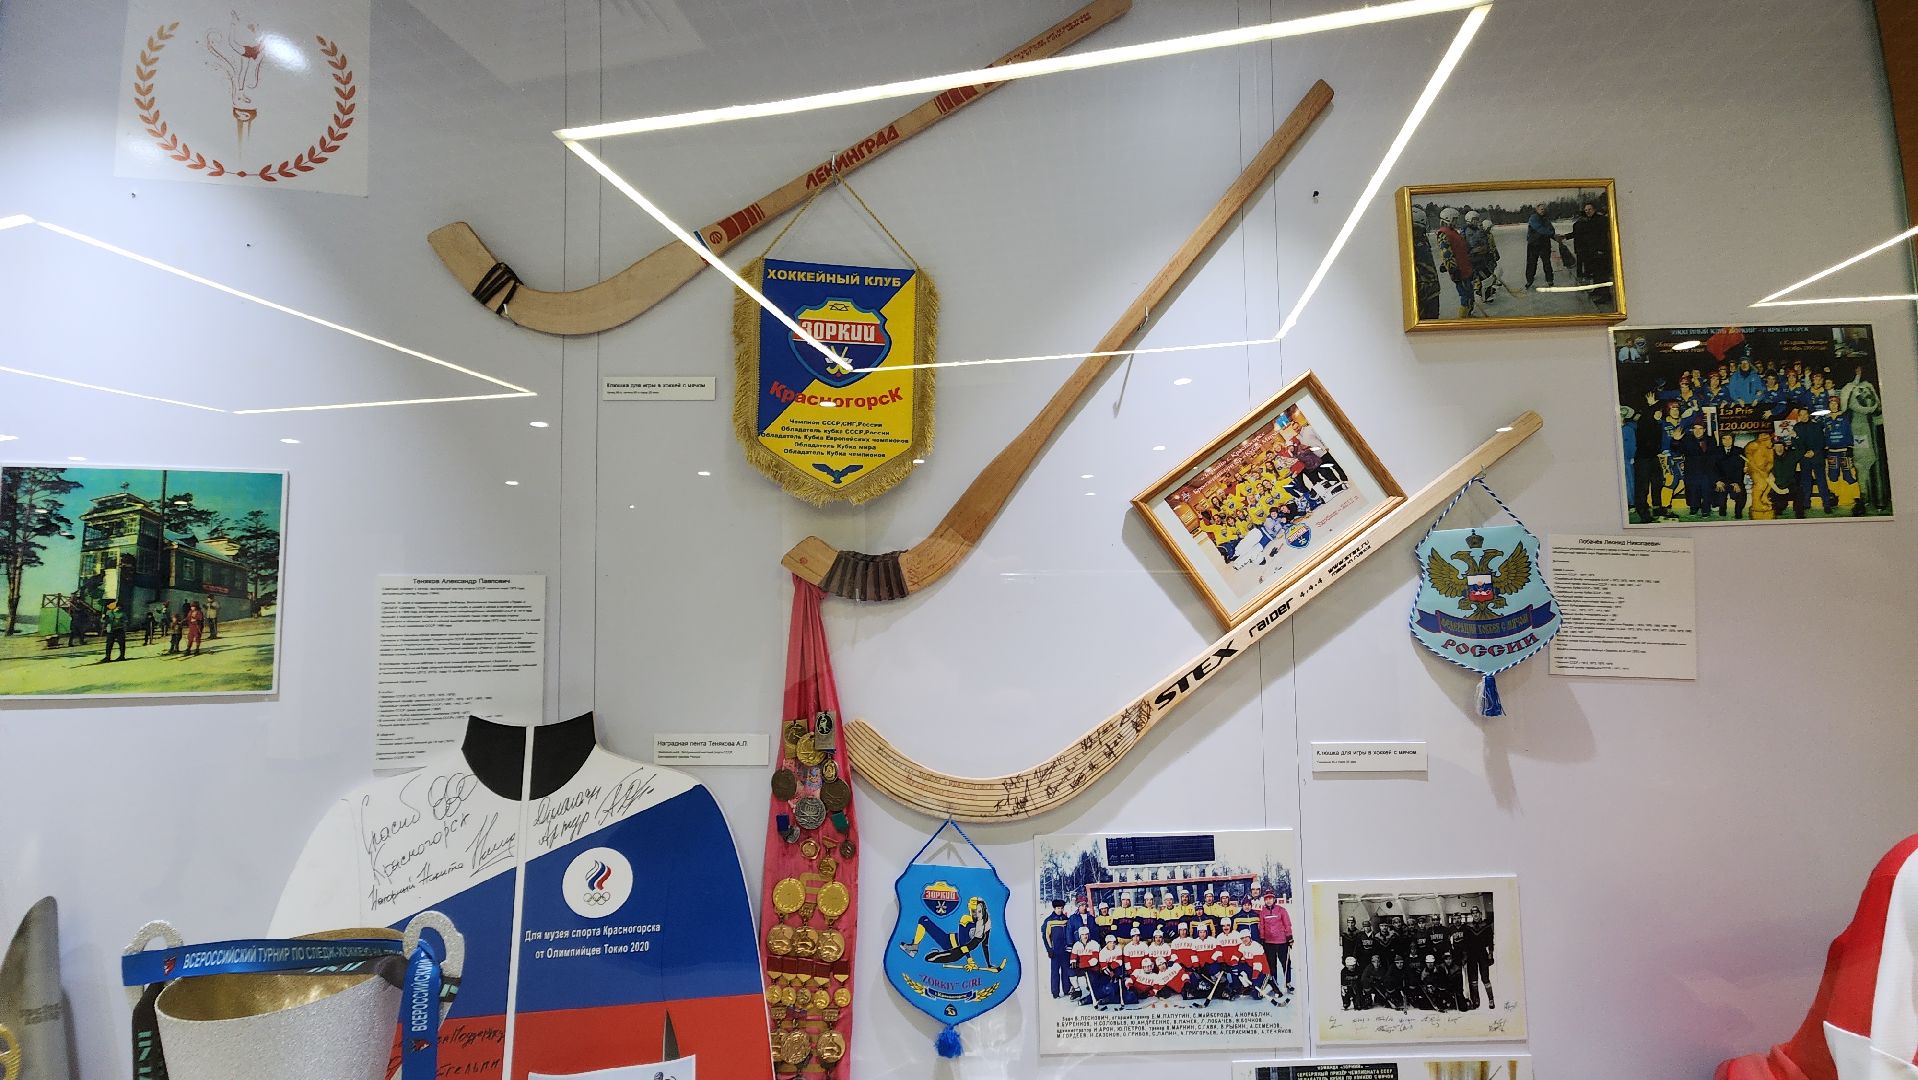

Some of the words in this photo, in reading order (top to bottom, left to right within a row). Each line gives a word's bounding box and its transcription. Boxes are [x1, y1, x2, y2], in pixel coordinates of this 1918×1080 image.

[806, 125, 899, 190] ЛЕНИНГРАД
[767, 269, 860, 285] ХОККЕЙНЫЙ
[865, 275, 901, 287] КЛУБ
[800, 321, 875, 342] ЗОРКИЙ
[769, 381, 903, 410] Красногорск
[1720, 422, 1759, 430] 120.000
[783, 448, 825, 456] Обладатель
[1441, 633, 1540, 657] РОССИИ
[1155, 639, 1239, 710] STEX
[525, 930, 542, 941] Для
[544, 930, 569, 941] музея
[571, 927, 600, 940] спорта
[603, 924, 661, 937] Красногорска
[183, 945, 256, 970] ВСЕРОССИЙСКИЙ
[258, 947, 290, 963] ТУРНИР
[291, 946, 304, 960] ПО
[535, 950, 544, 959] от
[546, 946, 601, 958] Олимпийцев
[603, 944, 628, 955] Токио
[630, 941, 649, 953] 2020
[410, 958, 433, 1031] ВСЕРОССИЙСКИЙ
